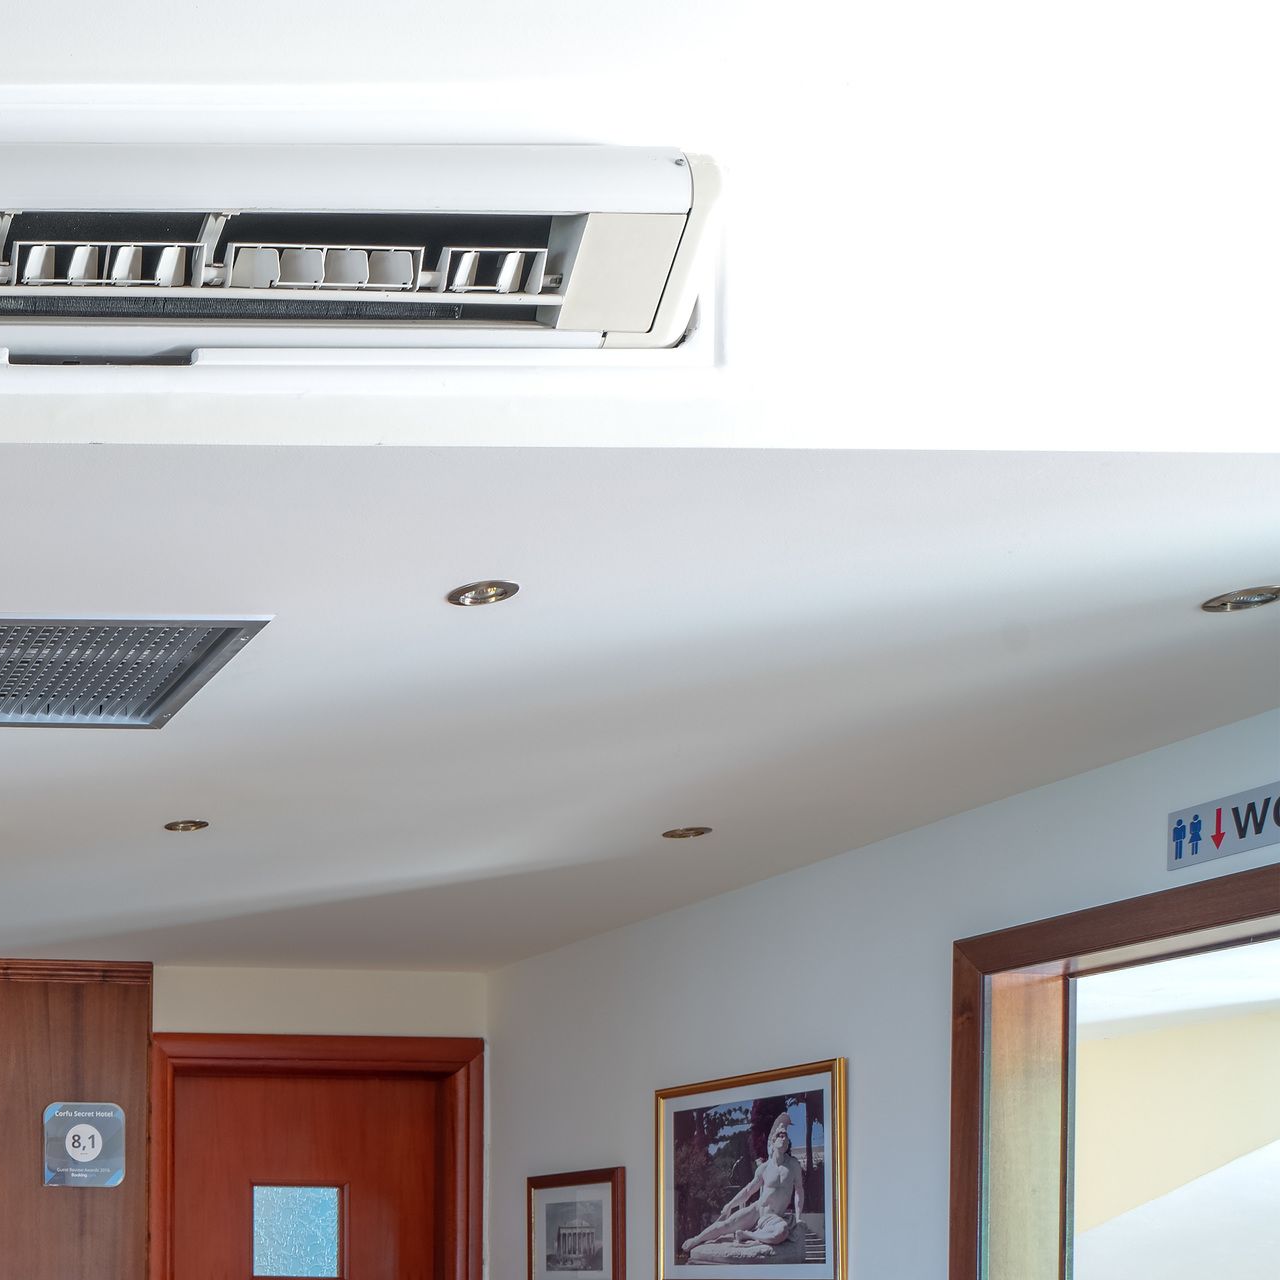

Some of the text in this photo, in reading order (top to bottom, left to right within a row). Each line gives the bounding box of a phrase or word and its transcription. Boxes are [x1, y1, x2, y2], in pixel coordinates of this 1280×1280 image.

[1231, 797, 1280, 840] W
[54, 1110, 73, 1118] Corfu
[73, 1110, 95, 1118] Secret
[71, 1134, 96, 1151] 8,1
